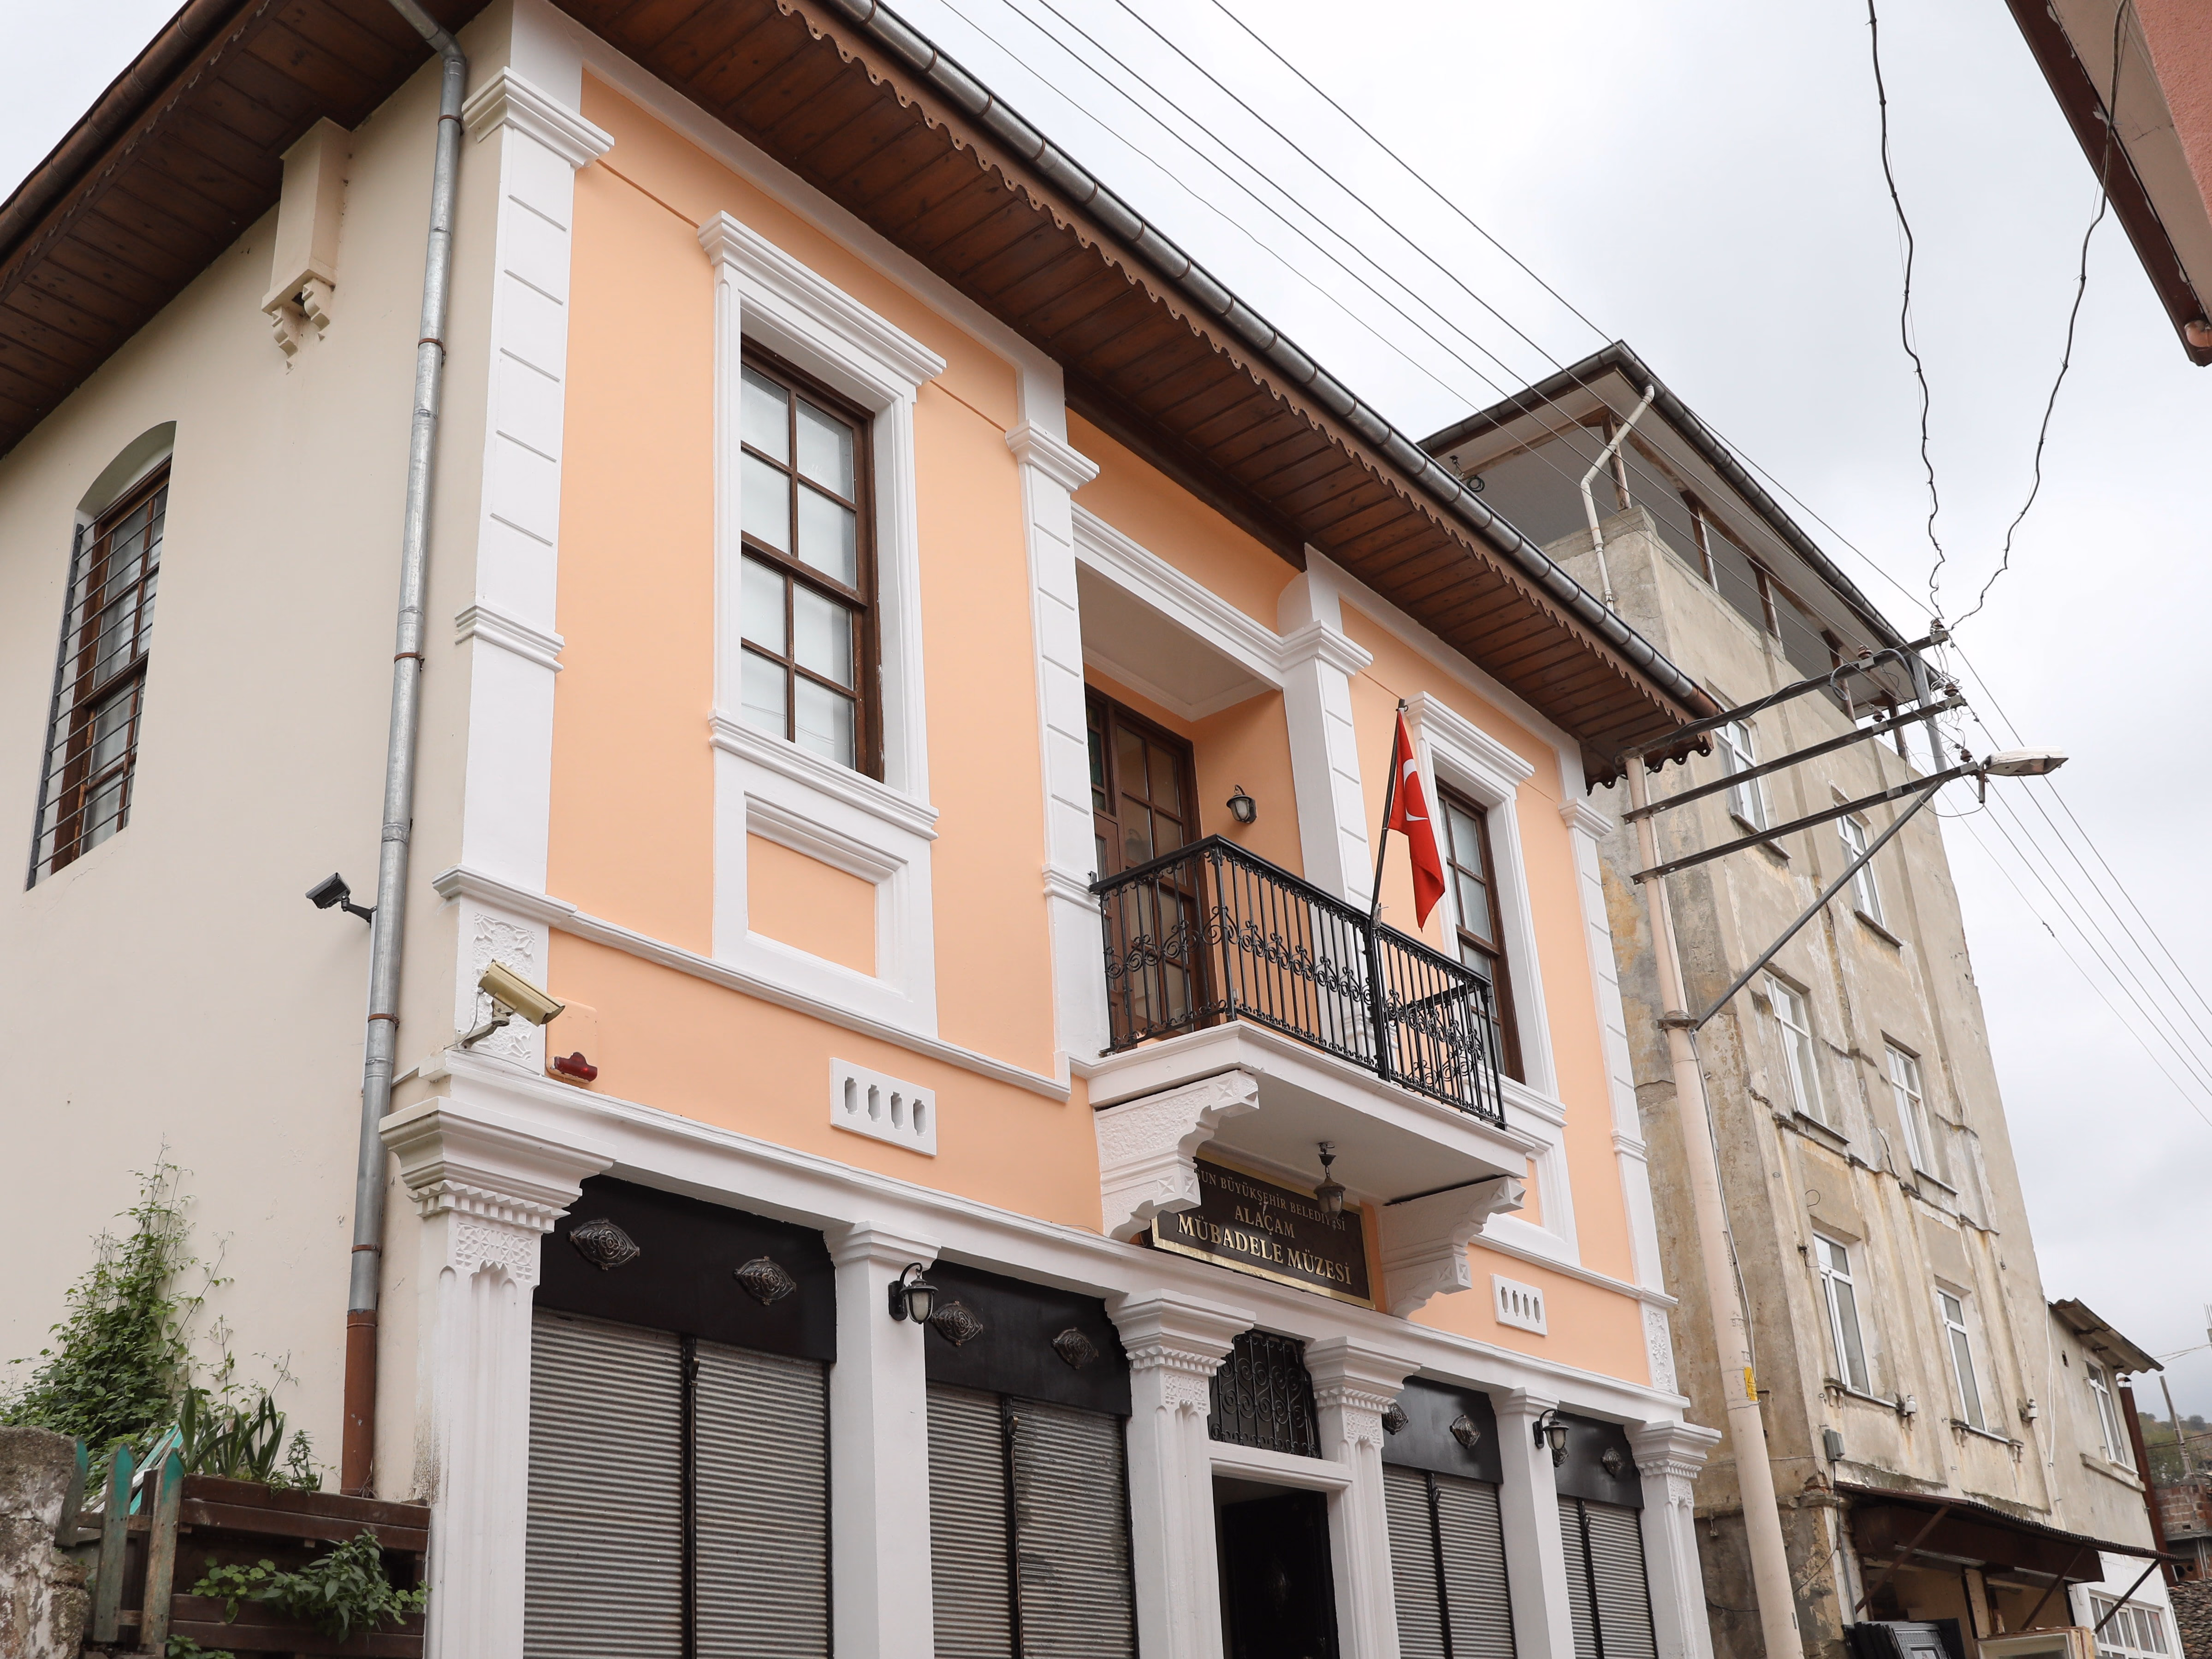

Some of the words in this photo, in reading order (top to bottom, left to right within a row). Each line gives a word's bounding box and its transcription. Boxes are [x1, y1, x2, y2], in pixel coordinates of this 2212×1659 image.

[1220, 1177, 1287, 1210] BÜYÜKŞEHİR
[1235, 1205, 1295, 1238] ALAÇAM
[1178, 1213, 1283, 1263] MÜBADELE
[1287, 1248, 1352, 1285] MÜZESİ
